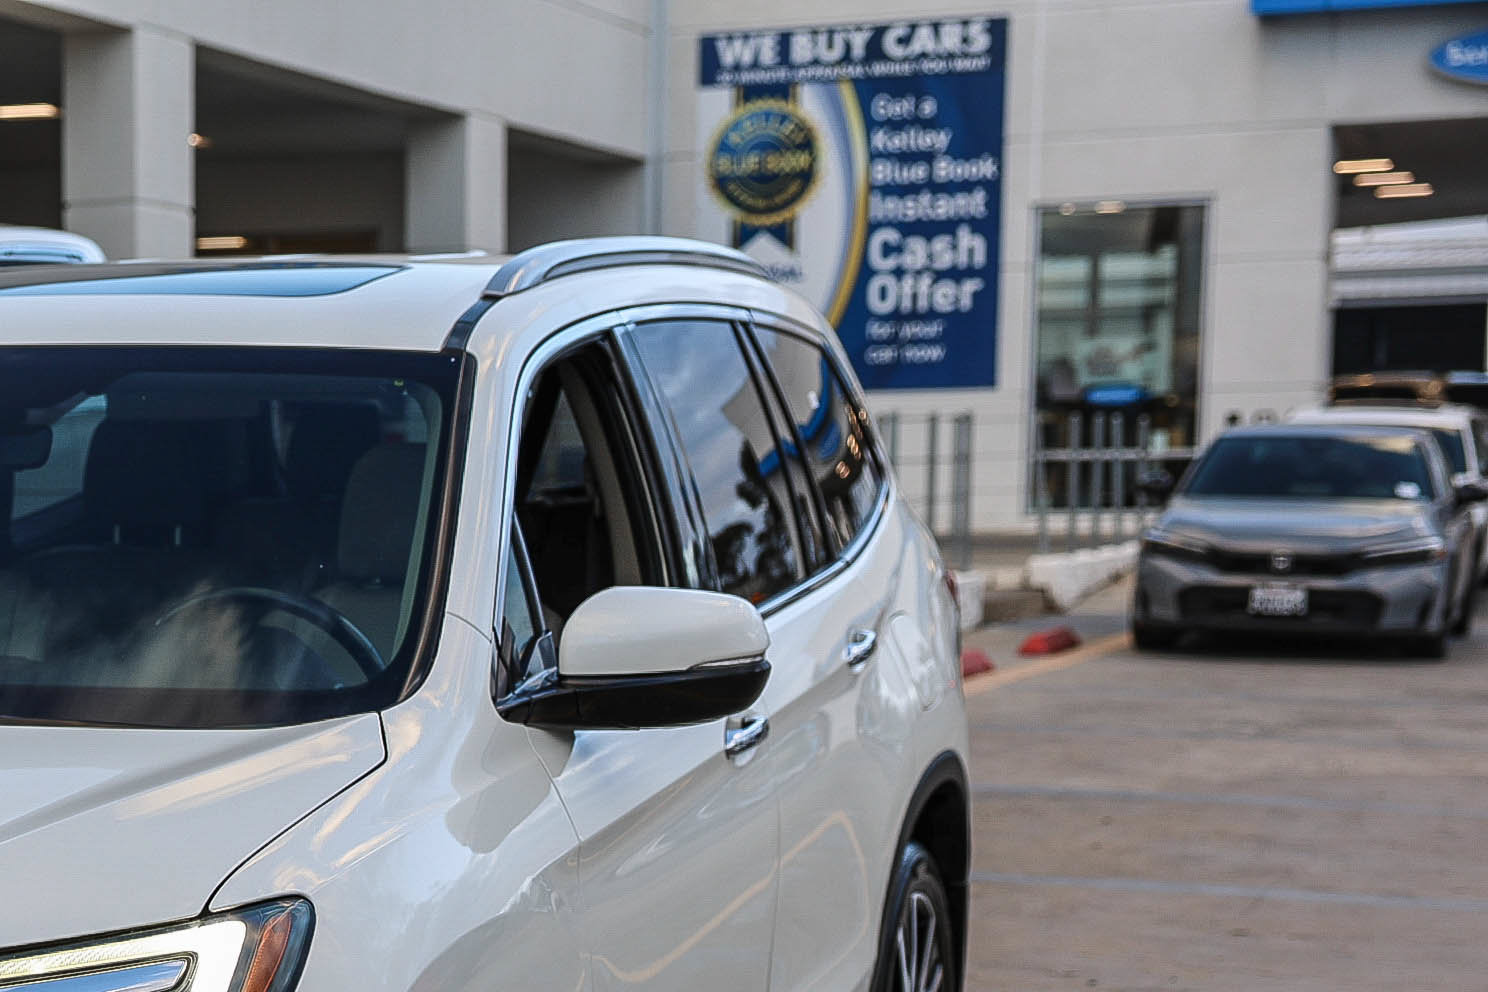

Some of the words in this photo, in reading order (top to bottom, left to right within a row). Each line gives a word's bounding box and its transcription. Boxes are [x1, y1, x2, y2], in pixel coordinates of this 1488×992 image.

[714, 34, 782, 68] WE
[788, 29, 873, 63] BUY
[881, 21, 992, 61] CARS
[871, 93, 916, 121] Get
[918, 96, 938, 119] a
[870, 124, 953, 156] Kelley
[716, 152, 761, 176] BLUE
[871, 157, 930, 186] Blue
[932, 153, 999, 183] Book
[869, 187, 988, 223] Instant
[868, 224, 988, 271] Cash
[866, 272, 985, 315] Offer
